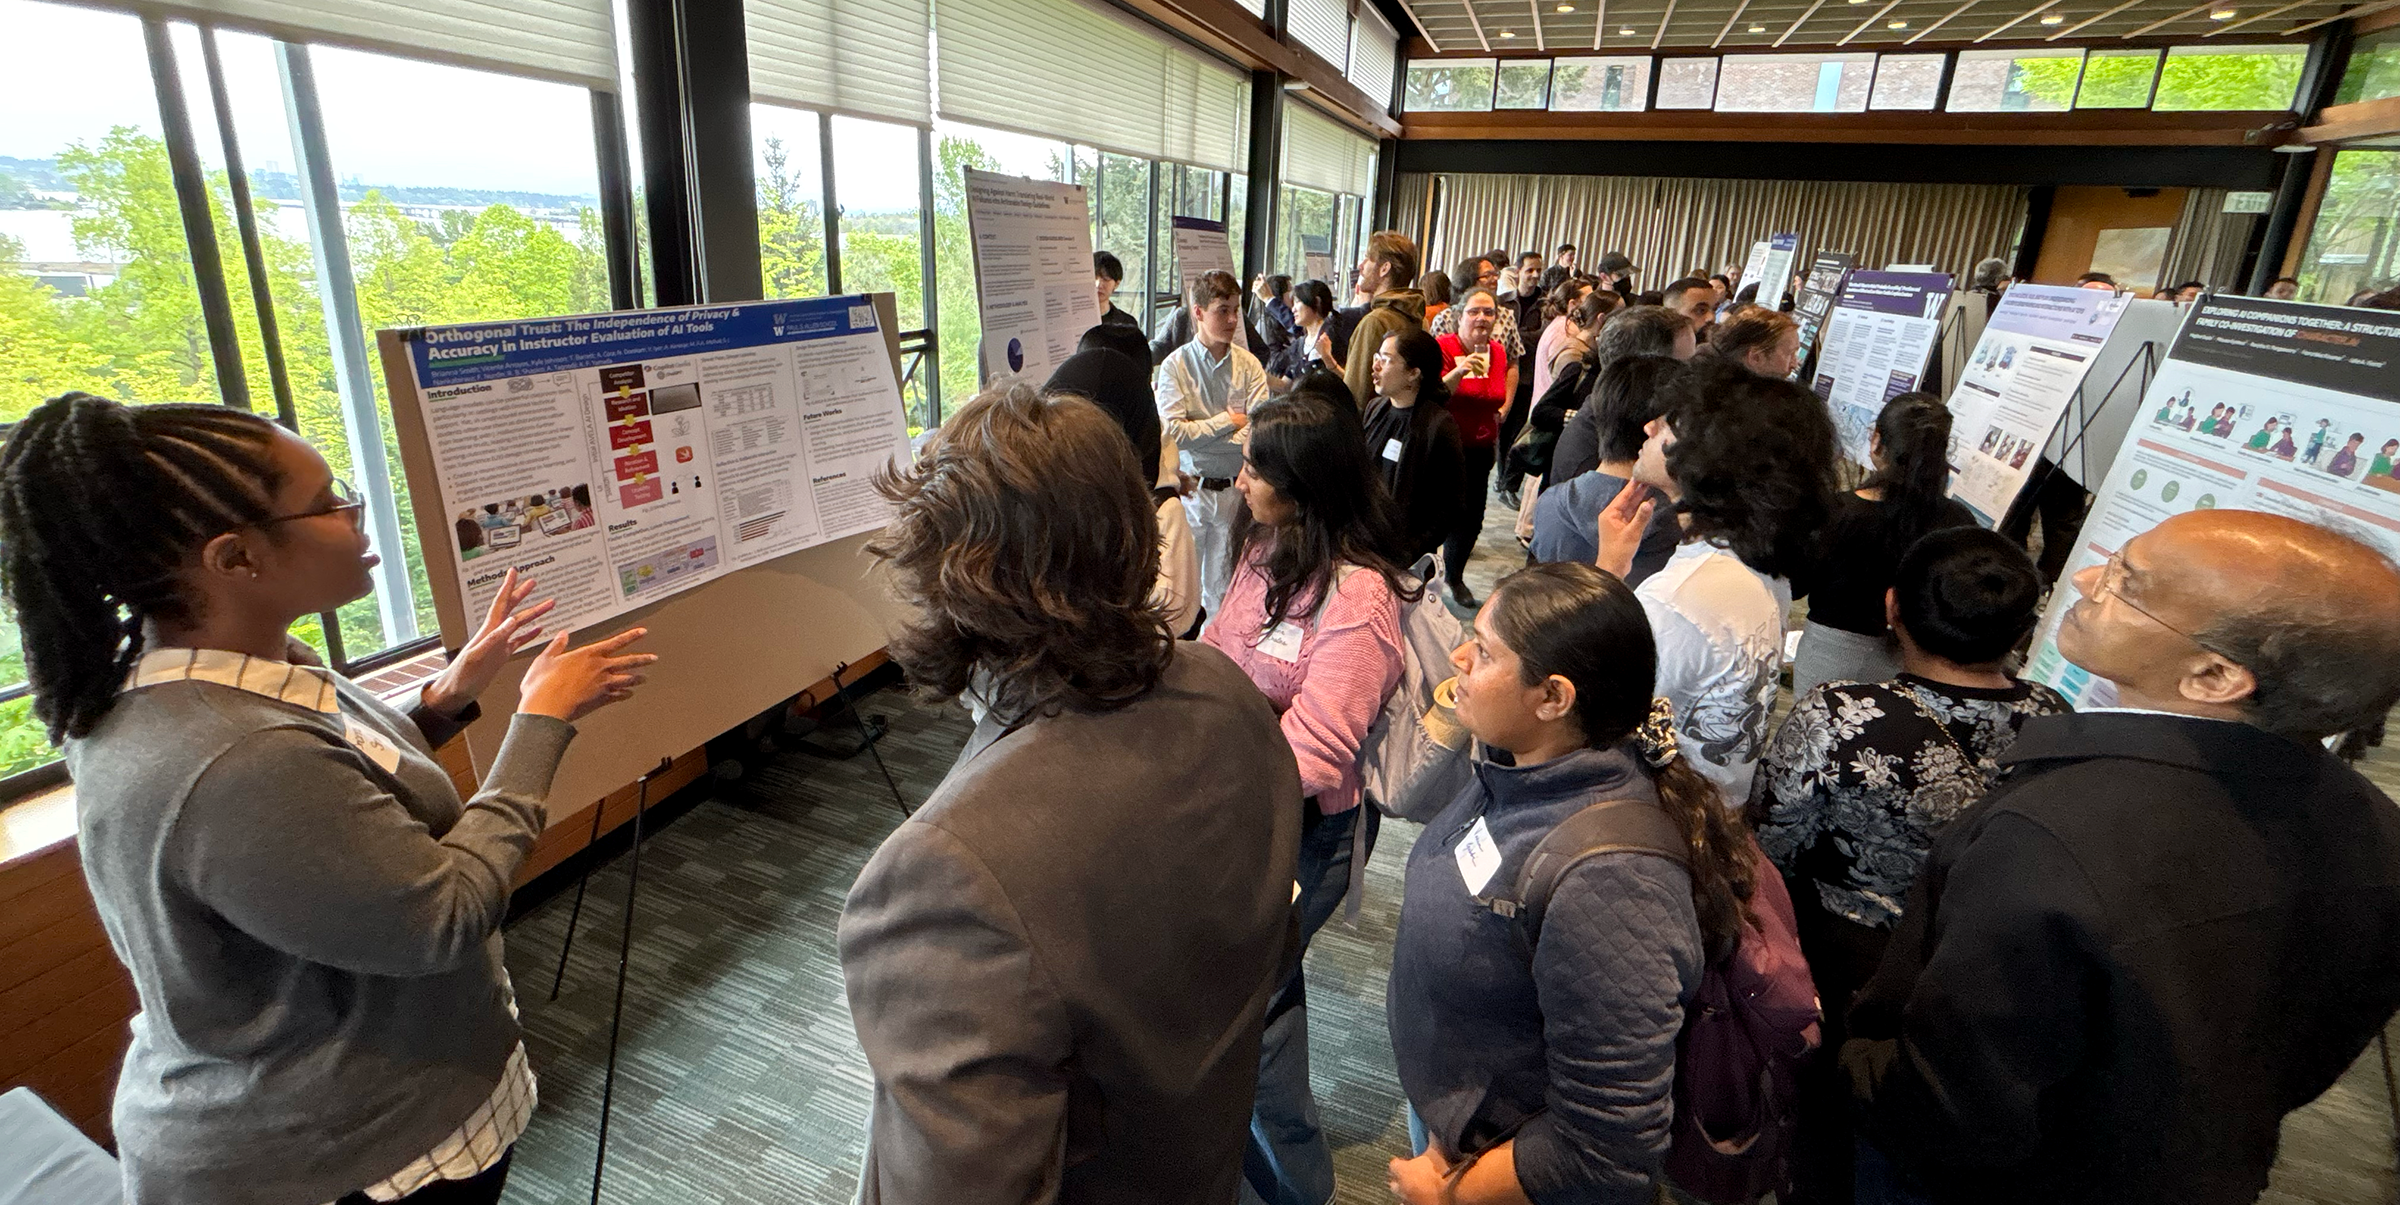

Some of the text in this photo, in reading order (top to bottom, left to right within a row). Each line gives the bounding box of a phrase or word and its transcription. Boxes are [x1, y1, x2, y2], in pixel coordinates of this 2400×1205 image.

[1923, 292, 1947, 320] W
[425, 308, 740, 344] Orthogonal Trust: The Independence of Privacy &
[773, 312, 788, 325] W
[2201, 306, 2240, 318] EXPLORING
[2238, 310, 2246, 319] AI
[2246, 311, 2298, 325] COMPANIONS
[2298, 316, 2343, 330] TOGETHER:
[2342, 322, 2352, 332] A
[773, 326, 784, 336] W
[2195, 317, 2220, 328] FAMILY
[2218, 320, 2285, 337] CO-INVESTIGATION
[2284, 329, 2298, 338] OF
[428, 322, 714, 360] Accuracy in Instructor Evaluation of AI Tools
[427, 384, 492, 400] Introduction
[804, 408, 842, 420] Future Works
[812, 472, 846, 484] References
[608, 520, 638, 532] Results
[514, 556, 556, 574] Approach
